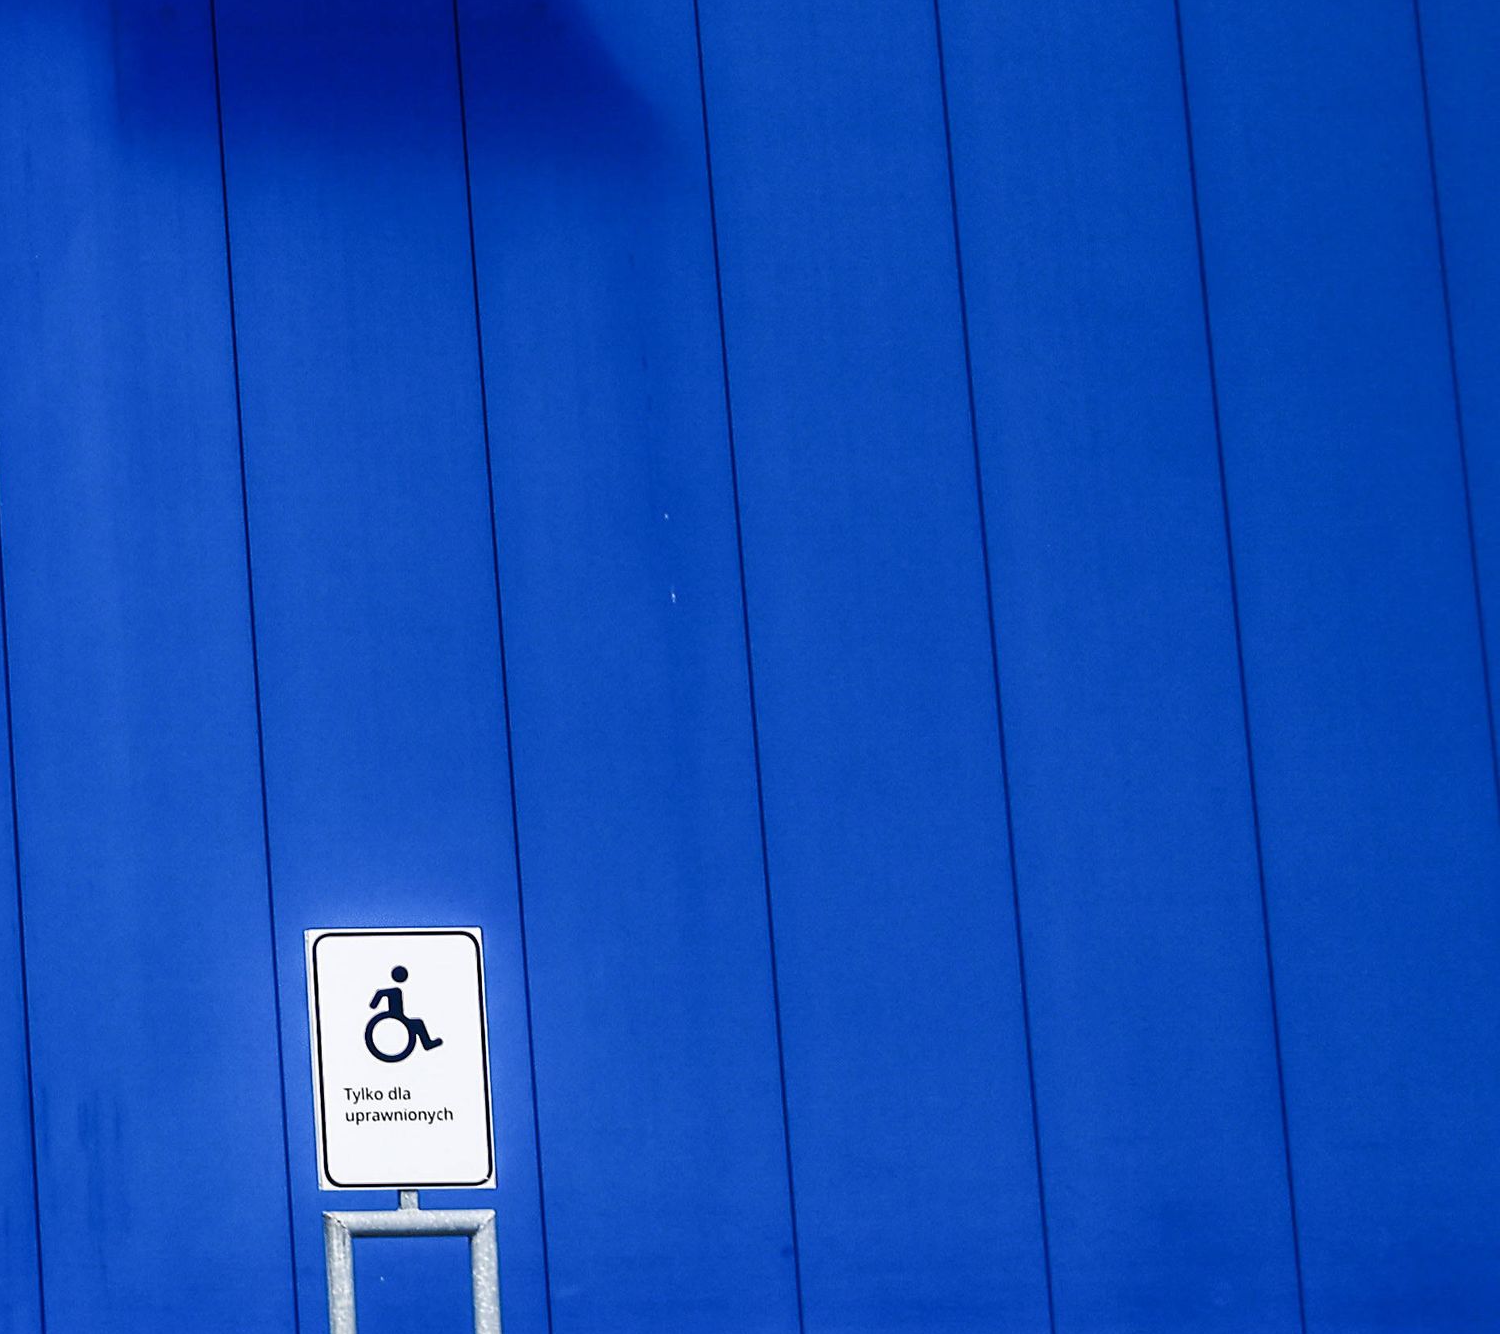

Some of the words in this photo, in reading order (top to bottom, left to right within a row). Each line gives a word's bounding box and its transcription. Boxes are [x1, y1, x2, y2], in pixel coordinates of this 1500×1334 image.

[344, 1087, 384, 1105] Tylko
[388, 1087, 412, 1101] dla
[346, 1107, 454, 1126] uprawnionych
